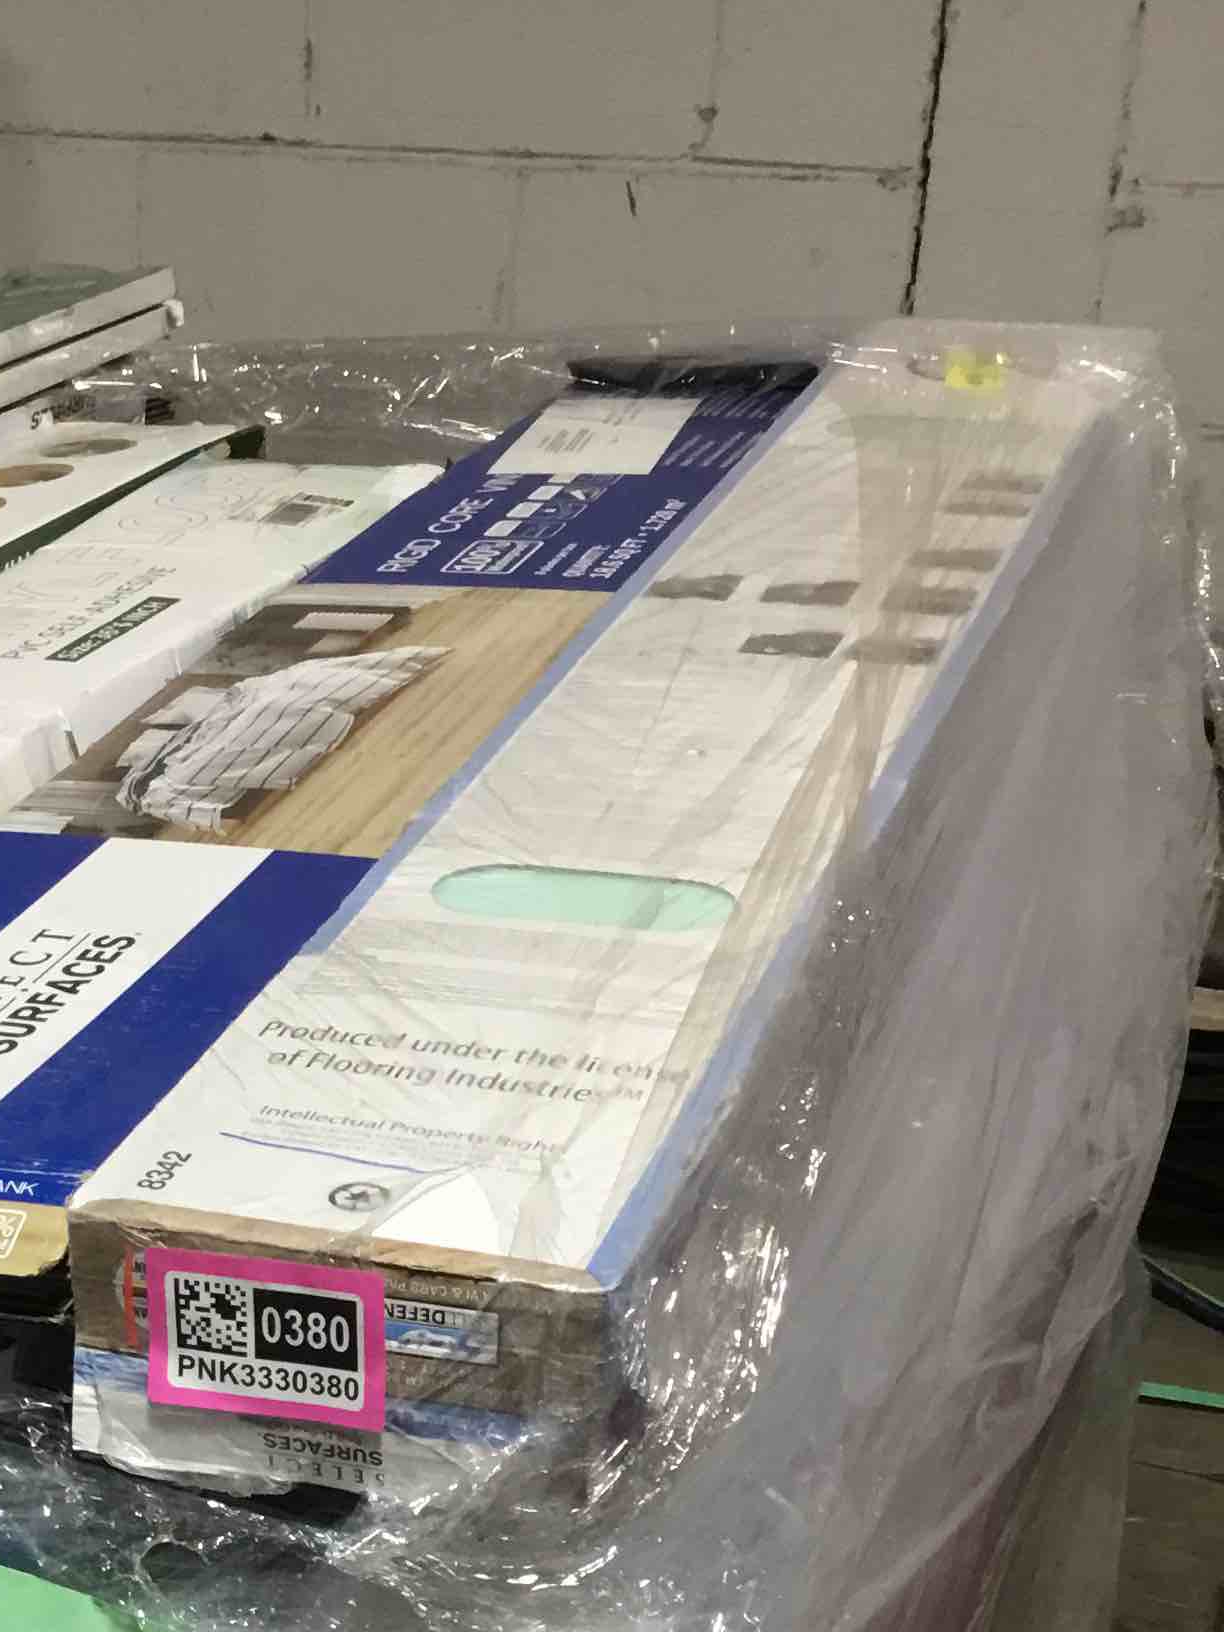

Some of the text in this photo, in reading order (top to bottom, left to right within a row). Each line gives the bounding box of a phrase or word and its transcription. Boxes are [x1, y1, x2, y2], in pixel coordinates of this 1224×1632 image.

[377, 537, 442, 573] RIGID
[428, 497, 495, 534] CORE
[257, 1018, 407, 1052] Produced
[411, 1034, 515, 1065] under
[515, 1047, 570, 1071] the
[267, 1049, 305, 1068] of
[305, 1051, 440, 1088] Flooring
[257, 1103, 386, 1132] Intellectual
[136, 1150, 193, 1191] 8342
[260, 1305, 352, 1355] 0380
[383, 1301, 447, 1327] DEFEN
[176, 1353, 361, 1402] PNK3330380
[261, 1431, 384, 1468] SURFACES
